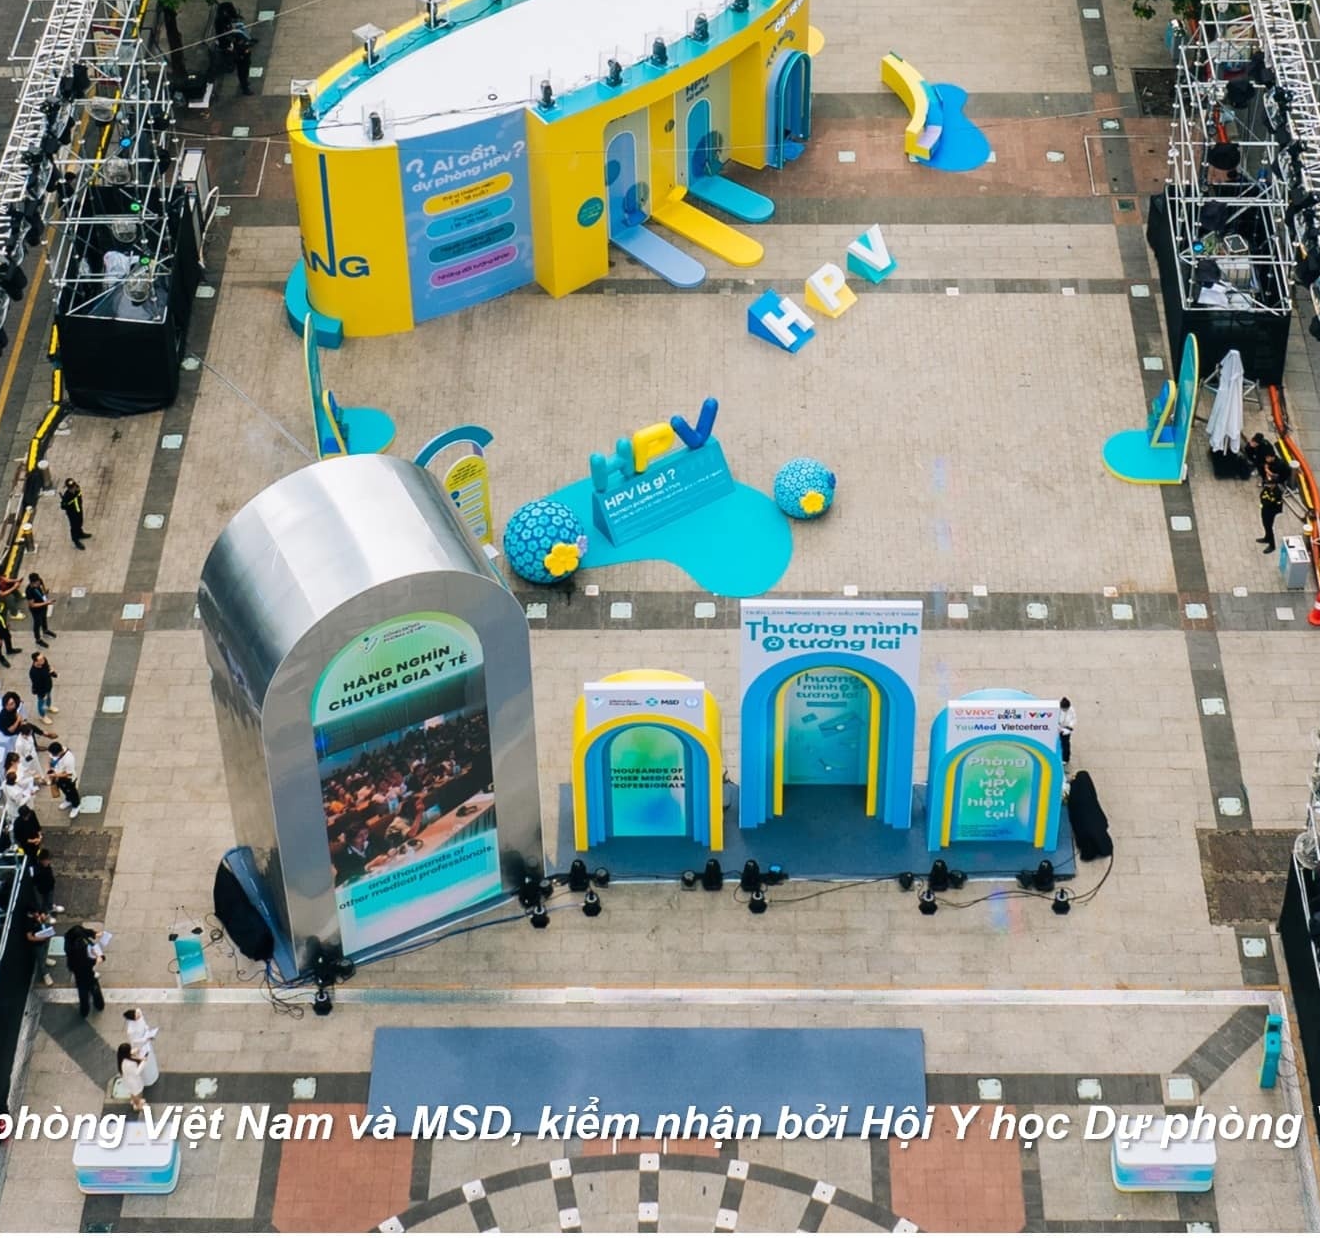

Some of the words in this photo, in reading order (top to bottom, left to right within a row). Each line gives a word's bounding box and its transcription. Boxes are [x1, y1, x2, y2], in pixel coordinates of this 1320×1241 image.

[685, 73, 710, 96] HPV
[412, 178, 433, 193] dự
[434, 165, 481, 189] phòng
[482, 154, 512, 171] HPV
[432, 155, 453, 176] Ai
[457, 143, 498, 165] cần
[762, 224, 890, 351] HPV
[590, 397, 718, 493] HPV
[604, 487, 635, 511] HPV
[745, 616, 847, 641] Thương
[853, 621, 918, 635] mình
[788, 638, 866, 652] tương
[871, 637, 900, 650] lai
[328, 678, 398, 711] CHUYÊN
[402, 667, 431, 685] GIA
[434, 662, 446, 672] Y
[448, 650, 468, 667] TẾ
[343, 667, 393, 692] HÀNG
[396, 645, 451, 673] NGHÌN
[967, 757, 1026, 767] Phòng
[979, 778, 1018, 788] HPV
[368, 875, 391, 890] and
[393, 852, 451, 881] thousands
[453, 846, 465, 855] of
[339, 894, 370, 910] other
[371, 875, 417, 897] medical
